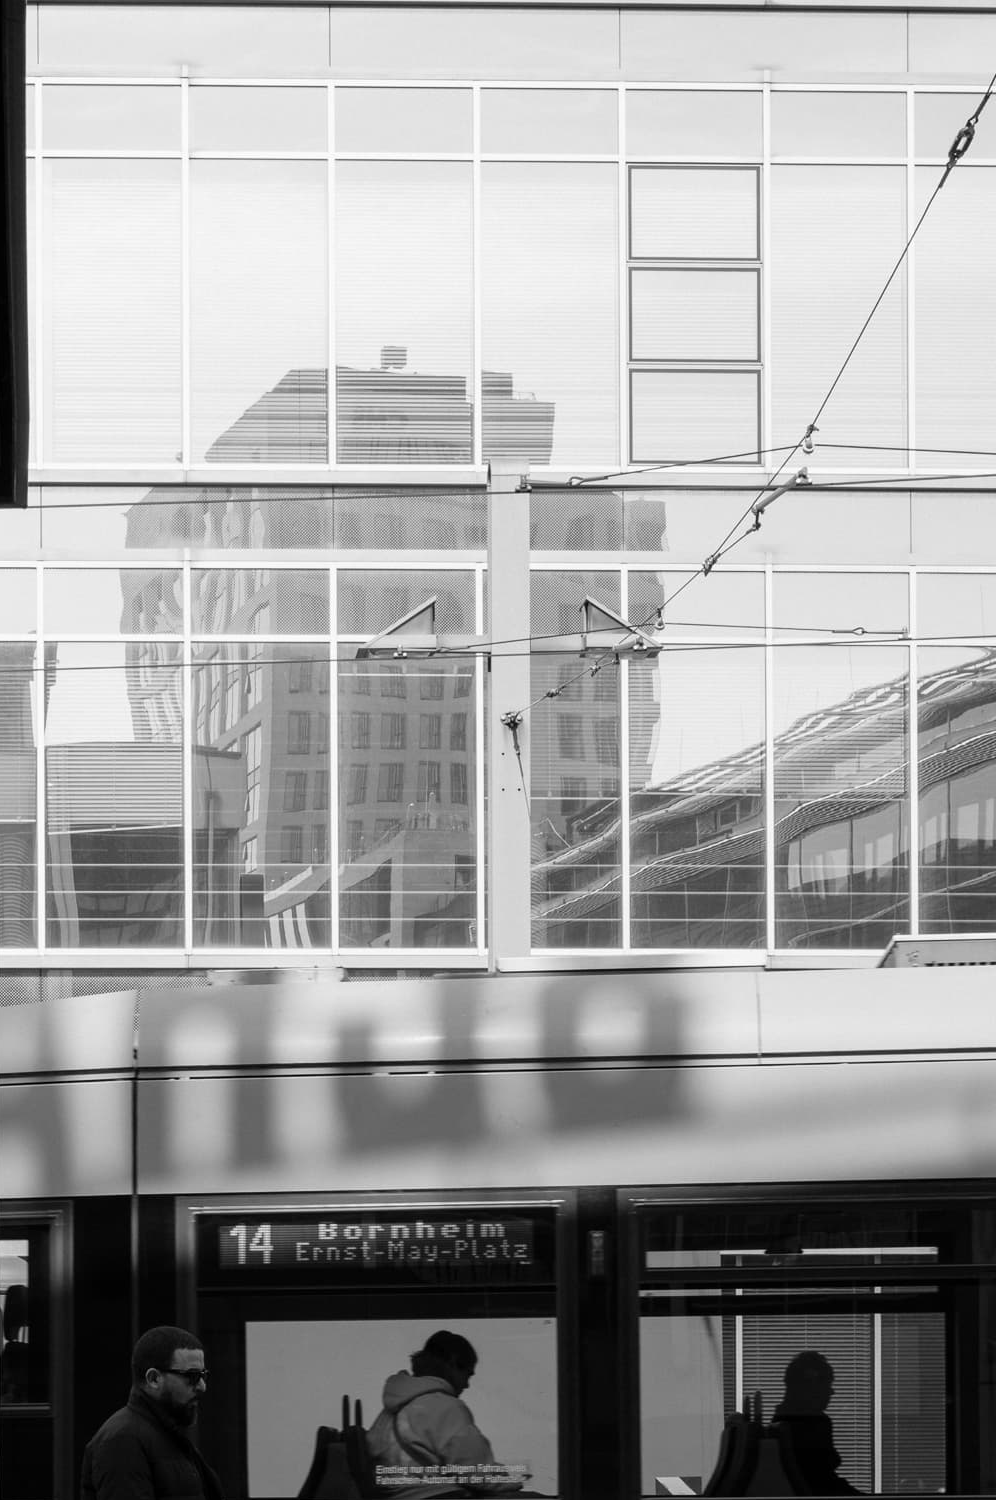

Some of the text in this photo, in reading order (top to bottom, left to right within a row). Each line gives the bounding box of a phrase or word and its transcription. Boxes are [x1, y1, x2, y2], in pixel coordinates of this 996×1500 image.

[318, 1221, 506, 1239] Bornheim
[229, 1224, 273, 1264] 14
[296, 1240, 532, 1264] Ernst-May-Platz
